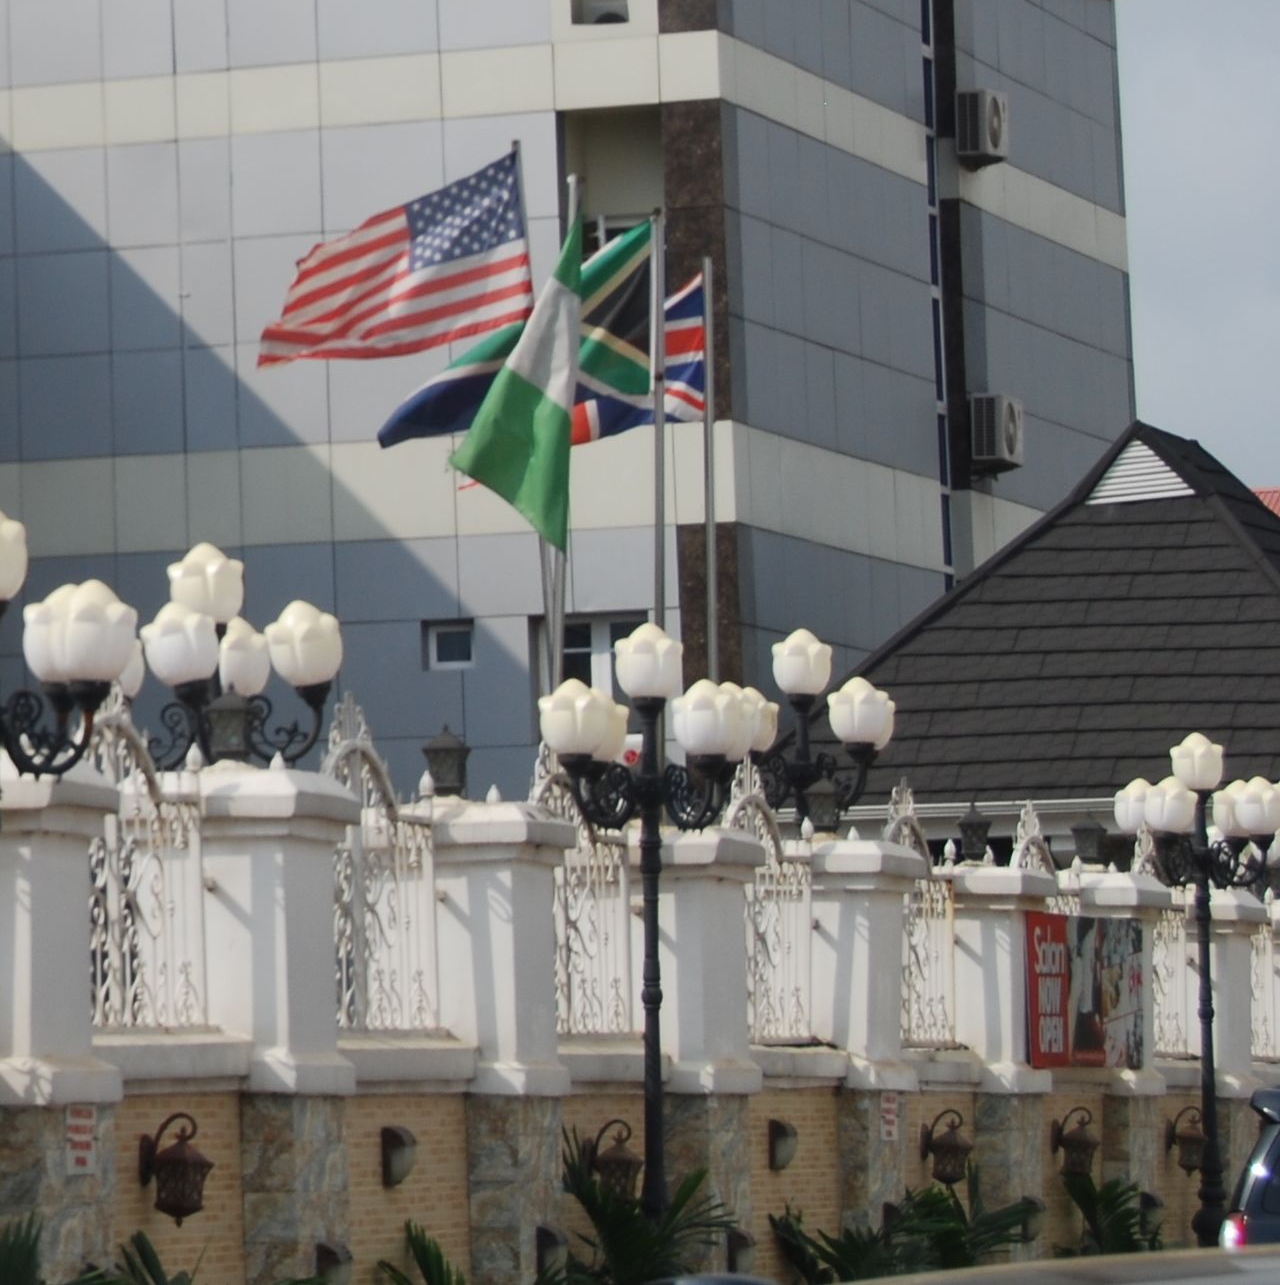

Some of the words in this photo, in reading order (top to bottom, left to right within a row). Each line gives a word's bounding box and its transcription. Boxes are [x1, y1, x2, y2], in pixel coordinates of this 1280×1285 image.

[1033, 925, 1066, 975] Salon
[1038, 976, 1062, 1014] NOW
[1039, 1016, 1064, 1054] OPEN
